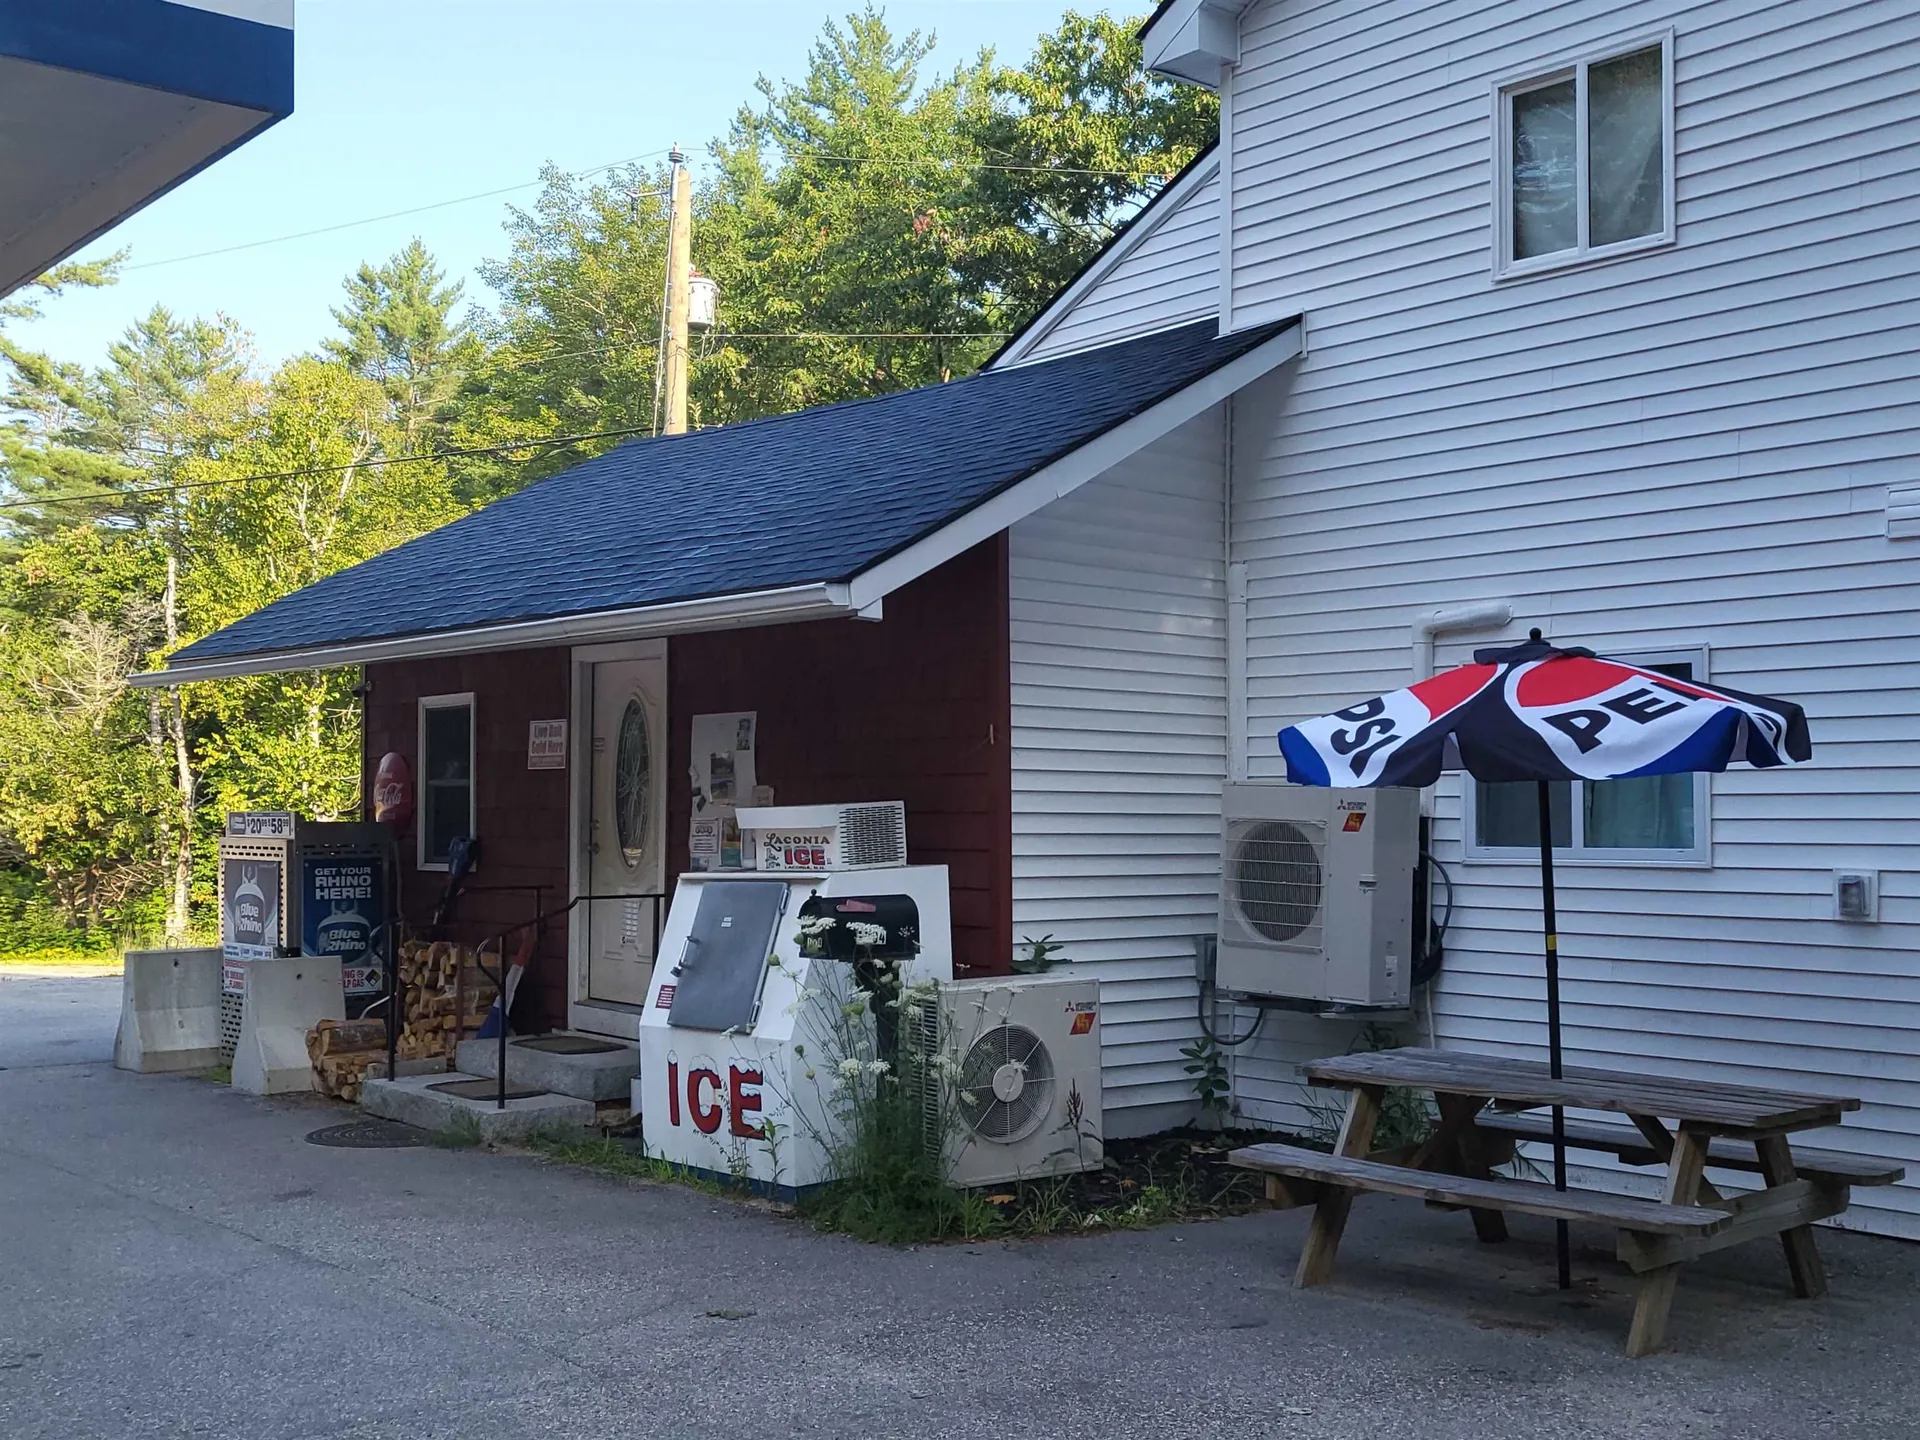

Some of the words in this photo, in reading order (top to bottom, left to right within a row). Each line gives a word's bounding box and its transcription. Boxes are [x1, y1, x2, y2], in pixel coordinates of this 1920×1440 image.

[534, 725, 548, 738] Live
[763, 832, 831, 852] LACONIA
[784, 845, 826, 865] ICE
[314, 867, 338, 876] GET
[340, 866, 371, 875] YOUR
[315, 875, 372, 887] RHINO
[315, 887, 372, 900] HERE!
[240, 902, 259, 917] Blue
[329, 929, 360, 939] Blue
[352, 979, 365, 988] GAS
[666, 1049, 766, 1141] ICE
